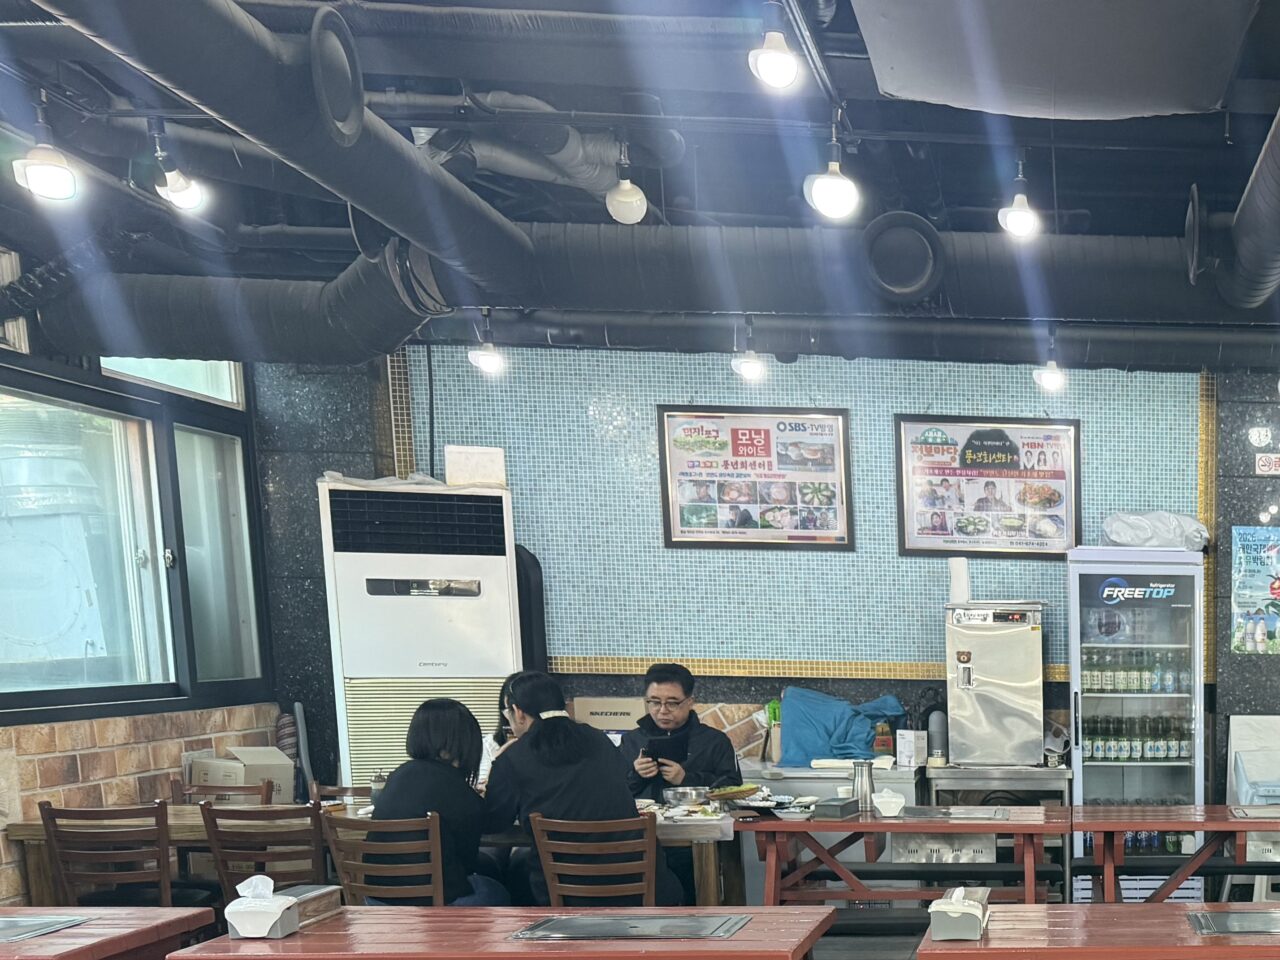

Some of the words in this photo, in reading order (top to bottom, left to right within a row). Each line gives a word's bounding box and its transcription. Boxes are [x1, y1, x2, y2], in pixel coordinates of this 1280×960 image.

[737, 430, 765, 445] 모닝
[737, 446, 767, 456] 와이드
[1102, 587, 1176, 600] FREETOP
